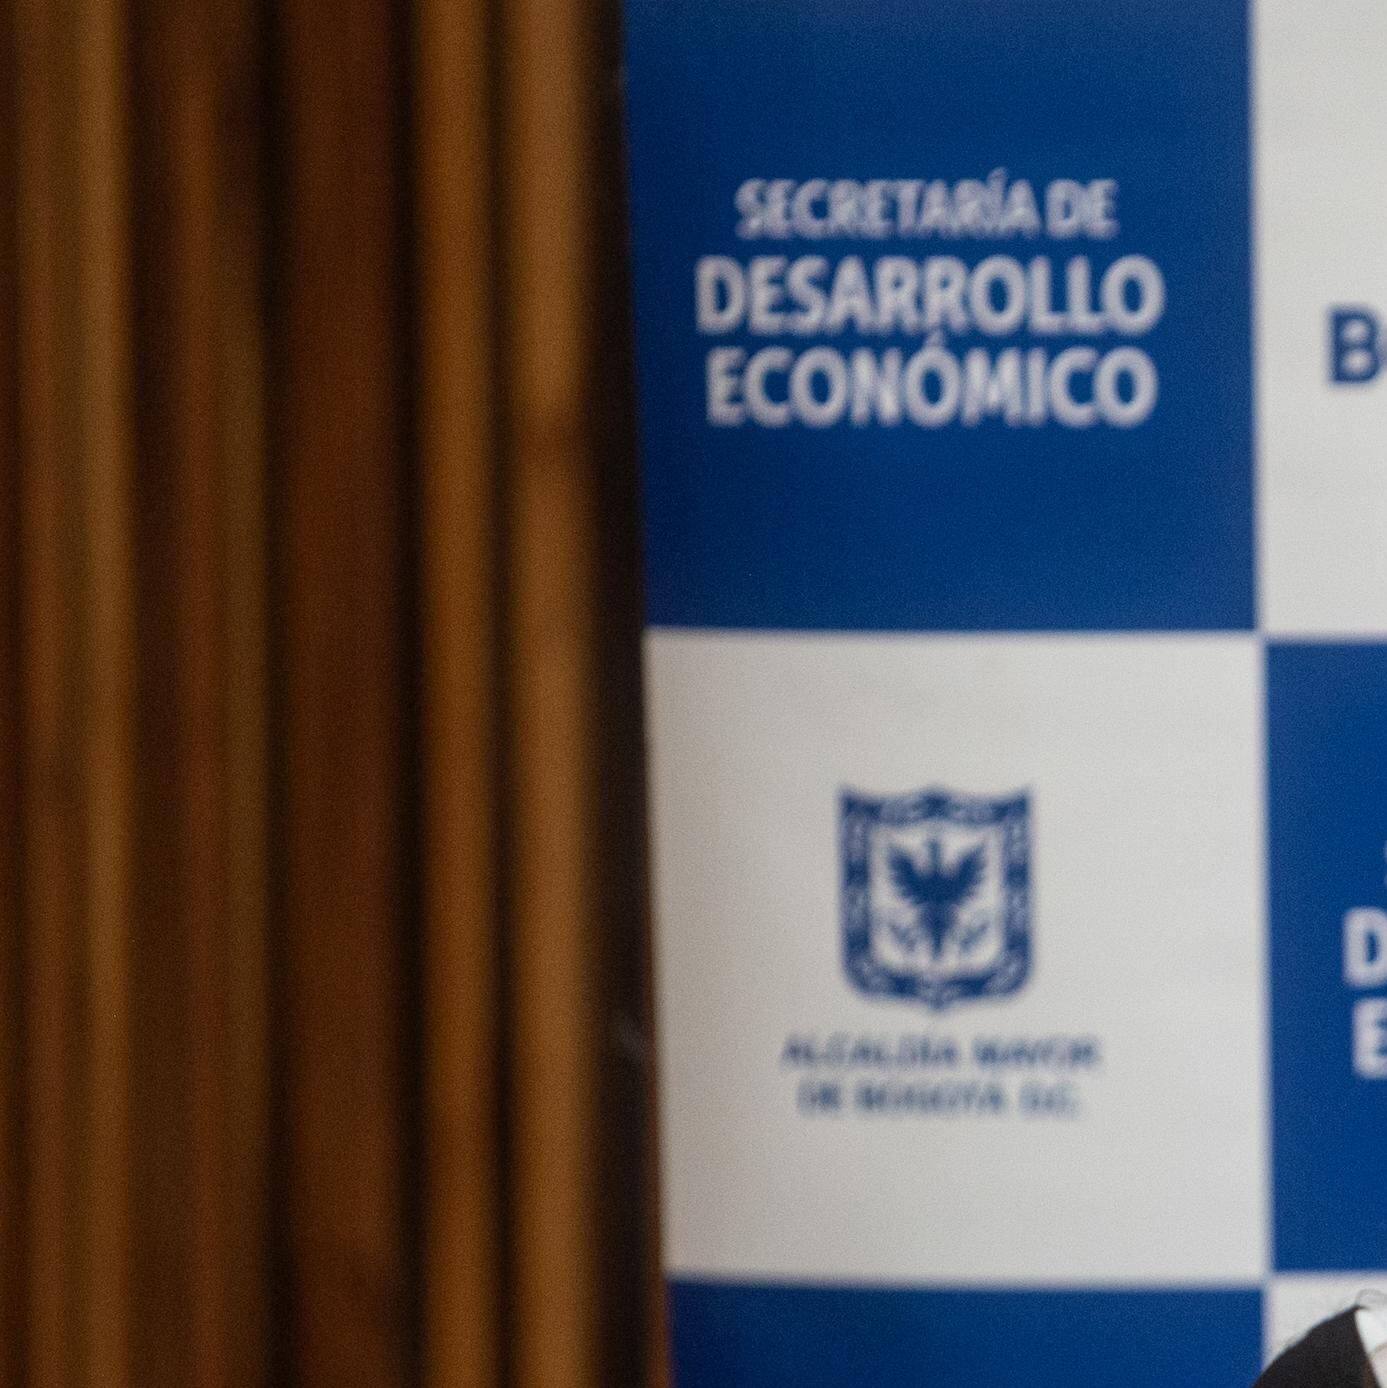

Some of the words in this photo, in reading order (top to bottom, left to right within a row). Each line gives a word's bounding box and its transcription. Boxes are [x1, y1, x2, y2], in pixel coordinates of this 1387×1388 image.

[736, 168, 1041, 238] SECRETARÍA
[1046, 179, 1117, 238] DE
[696, 254, 1166, 334] DESARROLLO
[707, 333, 1159, 428] ECONÓMICO
